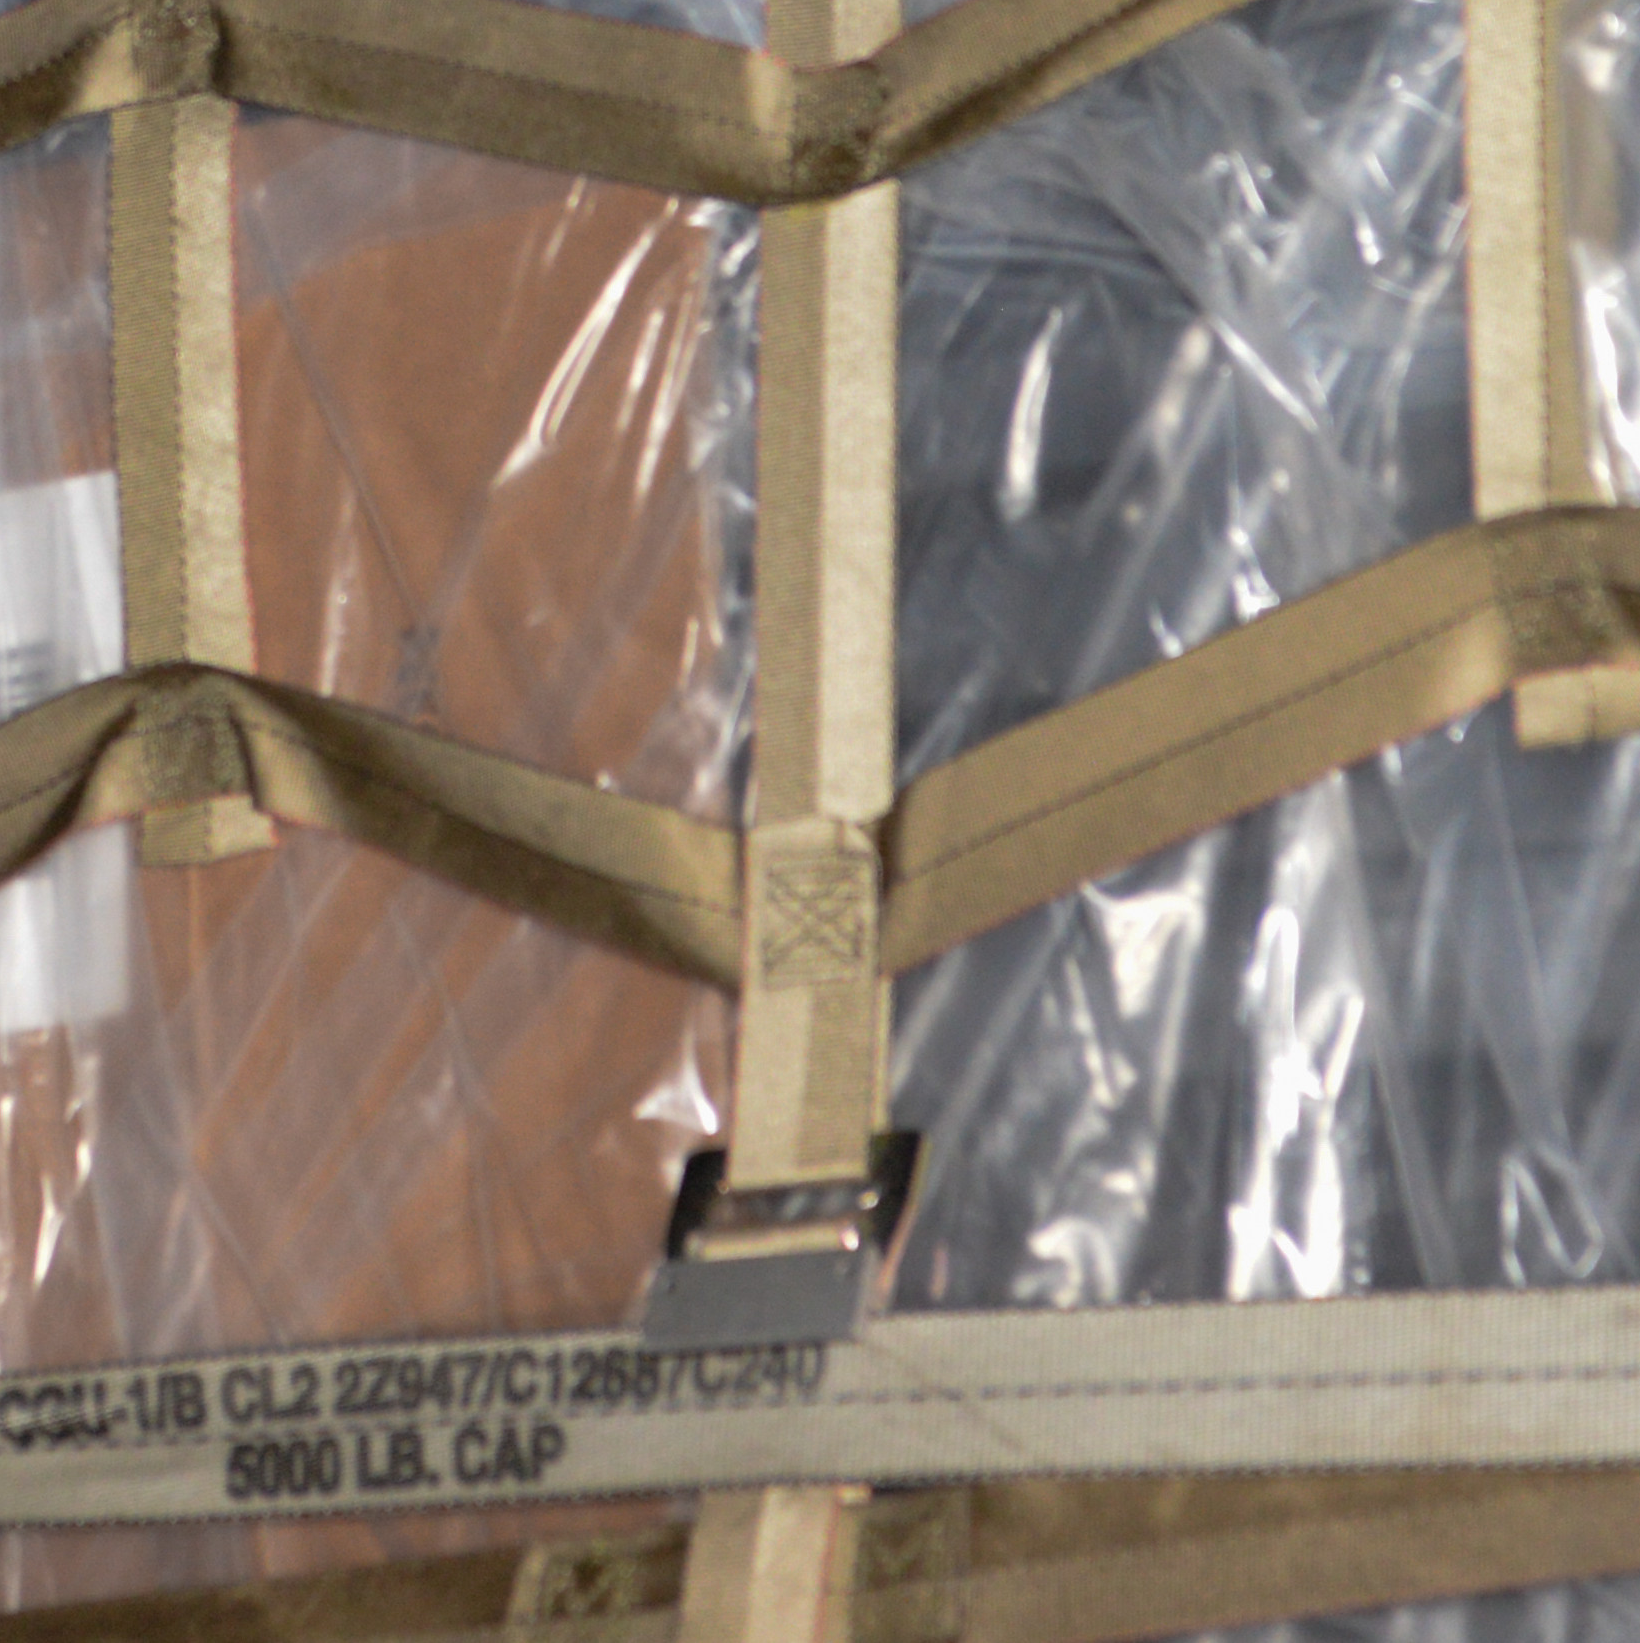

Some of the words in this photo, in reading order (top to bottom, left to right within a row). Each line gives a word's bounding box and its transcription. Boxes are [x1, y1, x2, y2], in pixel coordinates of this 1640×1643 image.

[221, 1364, 319, 1424] CL2
[226, 1437, 342, 1499] 5000
[357, 1429, 441, 1489] LB.
[454, 1421, 566, 1484] CAP
